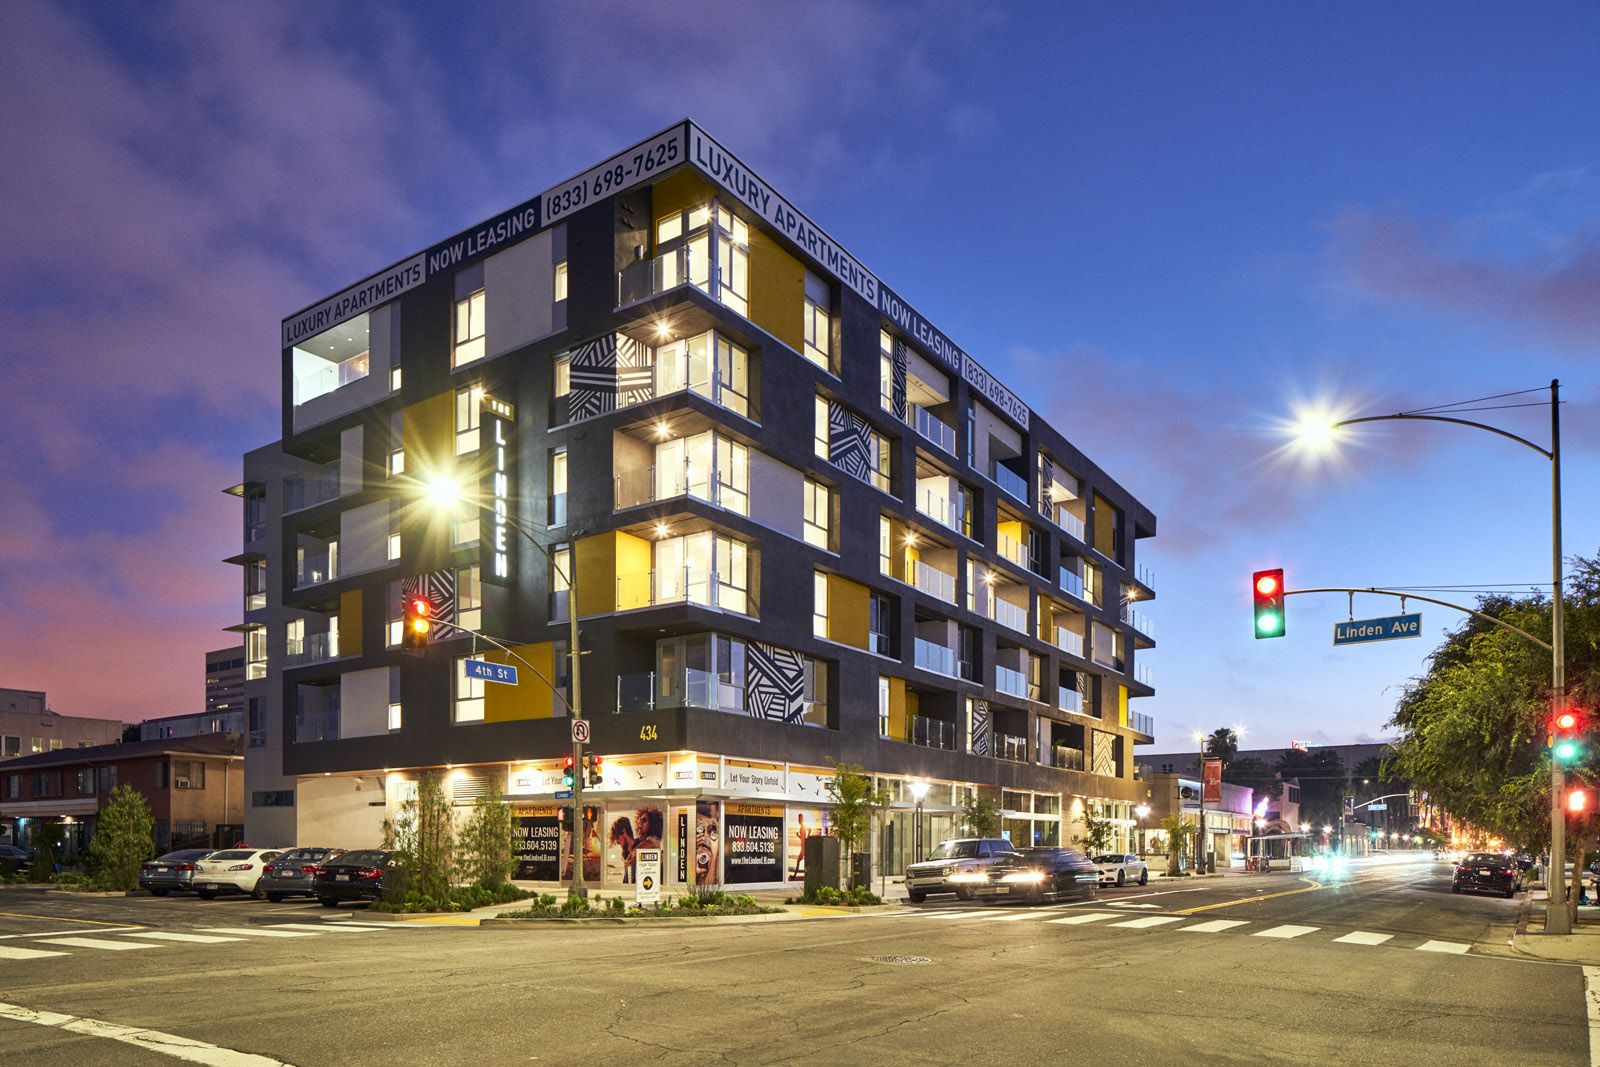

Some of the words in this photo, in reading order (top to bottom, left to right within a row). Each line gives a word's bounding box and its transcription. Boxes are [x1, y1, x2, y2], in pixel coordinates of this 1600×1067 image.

[546, 180, 588, 220] (833)
[593, 137, 678, 196] 698-7625
[697, 136, 770, 215] LUXURY
[774, 203, 875, 301] APARTMENTS
[430, 241, 464, 274] NOW
[467, 208, 535, 257] LEASING
[287, 306, 332, 342] LUXURY
[334, 263, 420, 320] APARTMENTS
[882, 290, 911, 329] NOW
[913, 316, 960, 370] LEASING
[964, 358, 987, 393] (833)
[989, 381, 1027, 427] 698-7625
[495, 419, 507, 578] LINDEN
[1337, 625, 1383, 639] Linden
[1391, 621, 1418, 634] Ave
[475, 665, 492, 677] 4th
[498, 668, 508, 680] St
[640, 725, 658, 741] 434
[730, 773, 738, 782] Let
[740, 774, 750, 784] Your
[751, 775, 763, 786] Story
[764, 777, 779, 786] Unfold
[518, 806, 553, 815] APARTMENTS
[737, 804, 771, 815] APARTMENTS
[530, 826, 559, 838] LEASING
[728, 825, 747, 839] NOW
[749, 825, 779, 840] LEASING
[513, 840, 557, 851] 3.604.5139
[732, 841, 775, 853] 833.604.5139
